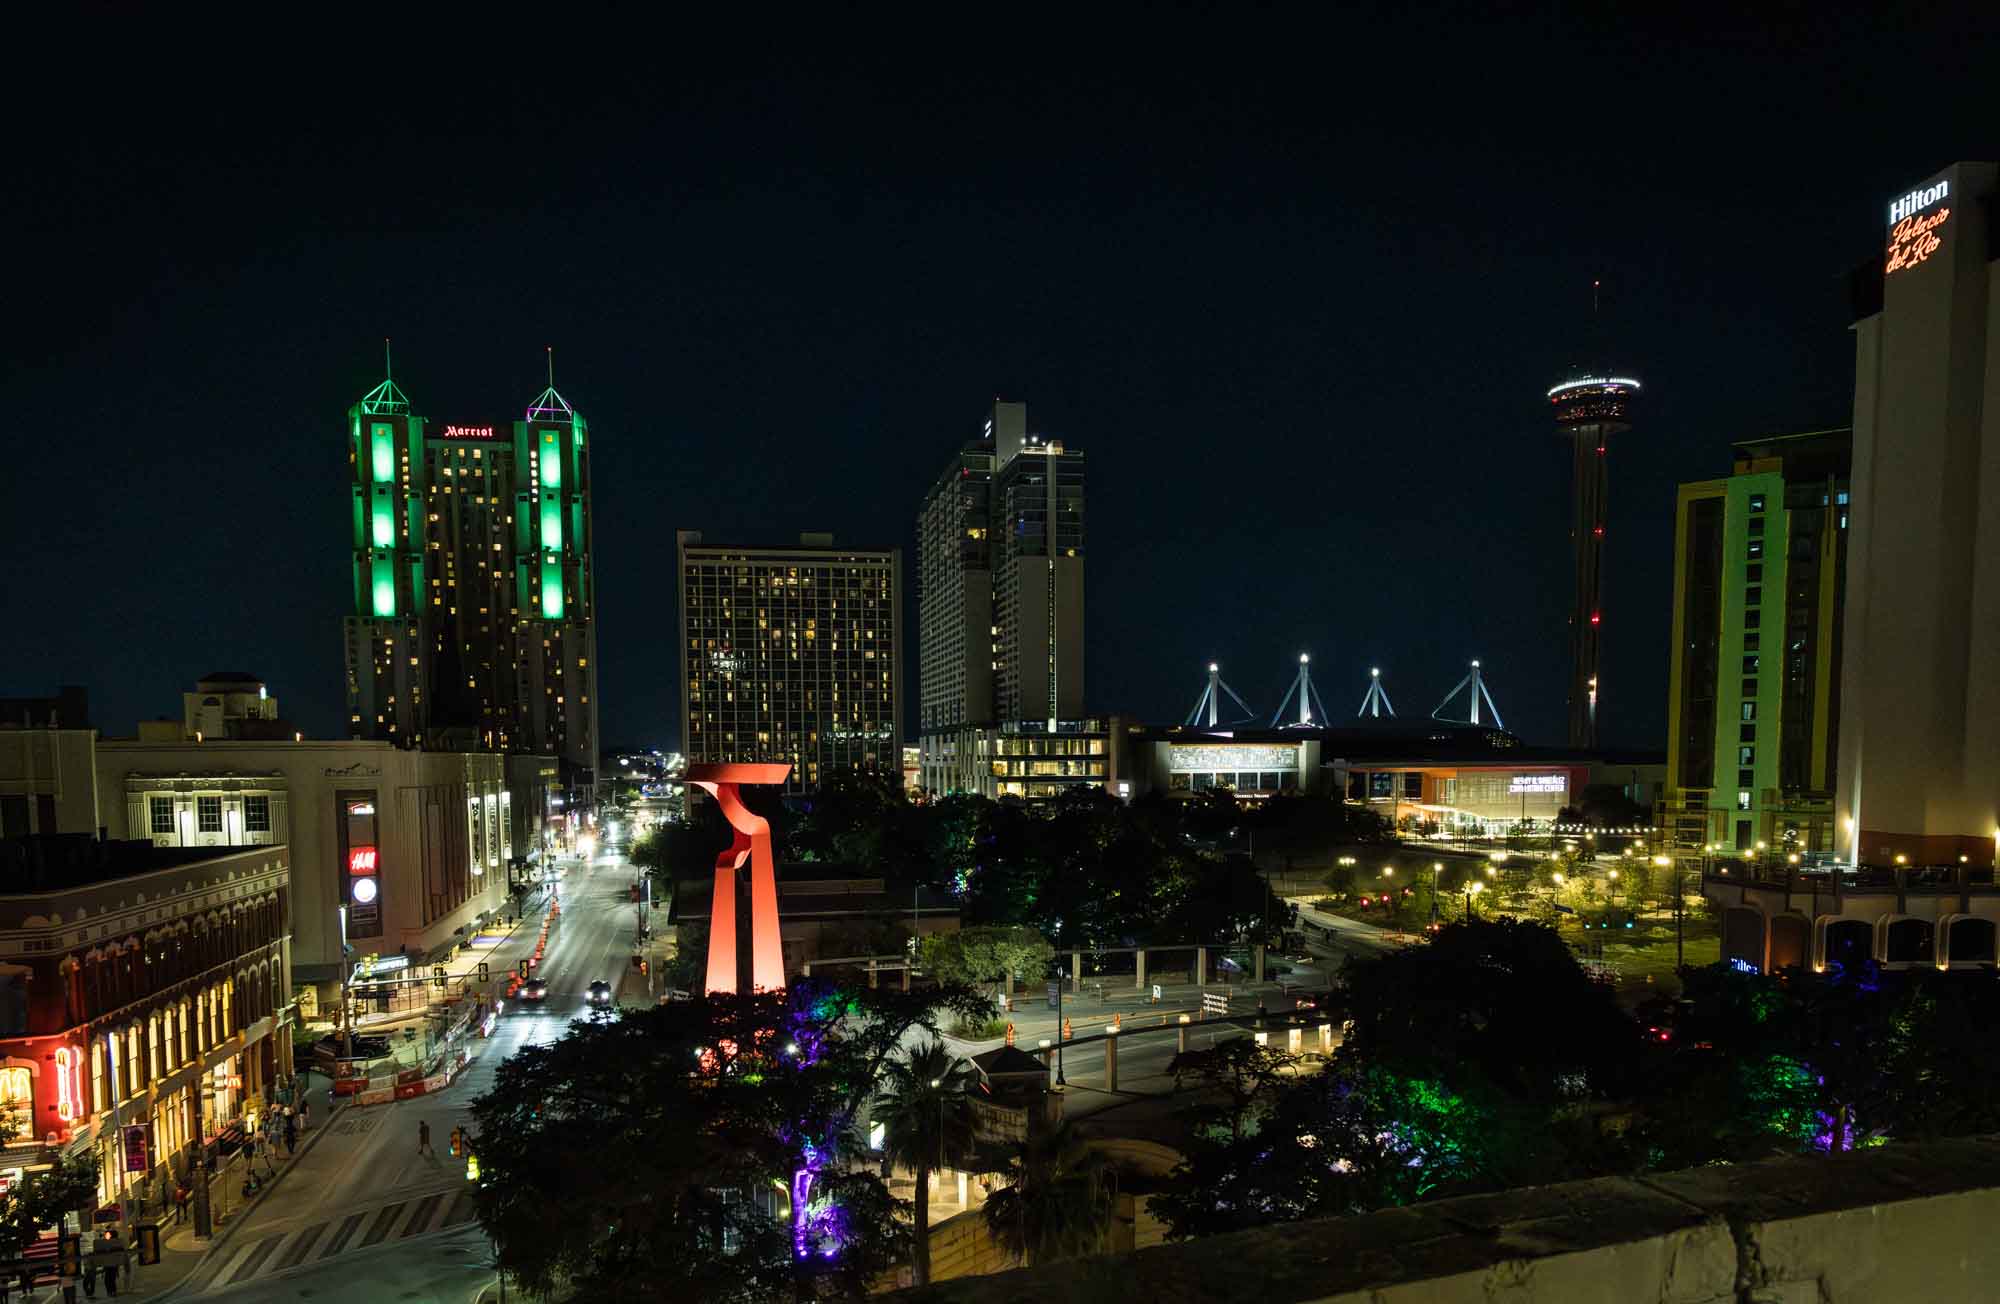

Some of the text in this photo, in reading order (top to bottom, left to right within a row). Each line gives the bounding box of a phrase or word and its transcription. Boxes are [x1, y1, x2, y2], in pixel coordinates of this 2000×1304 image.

[1891, 181, 1948, 224] Hilton
[1889, 208, 1950, 252] Palacio
[1886, 246, 1911, 273] del
